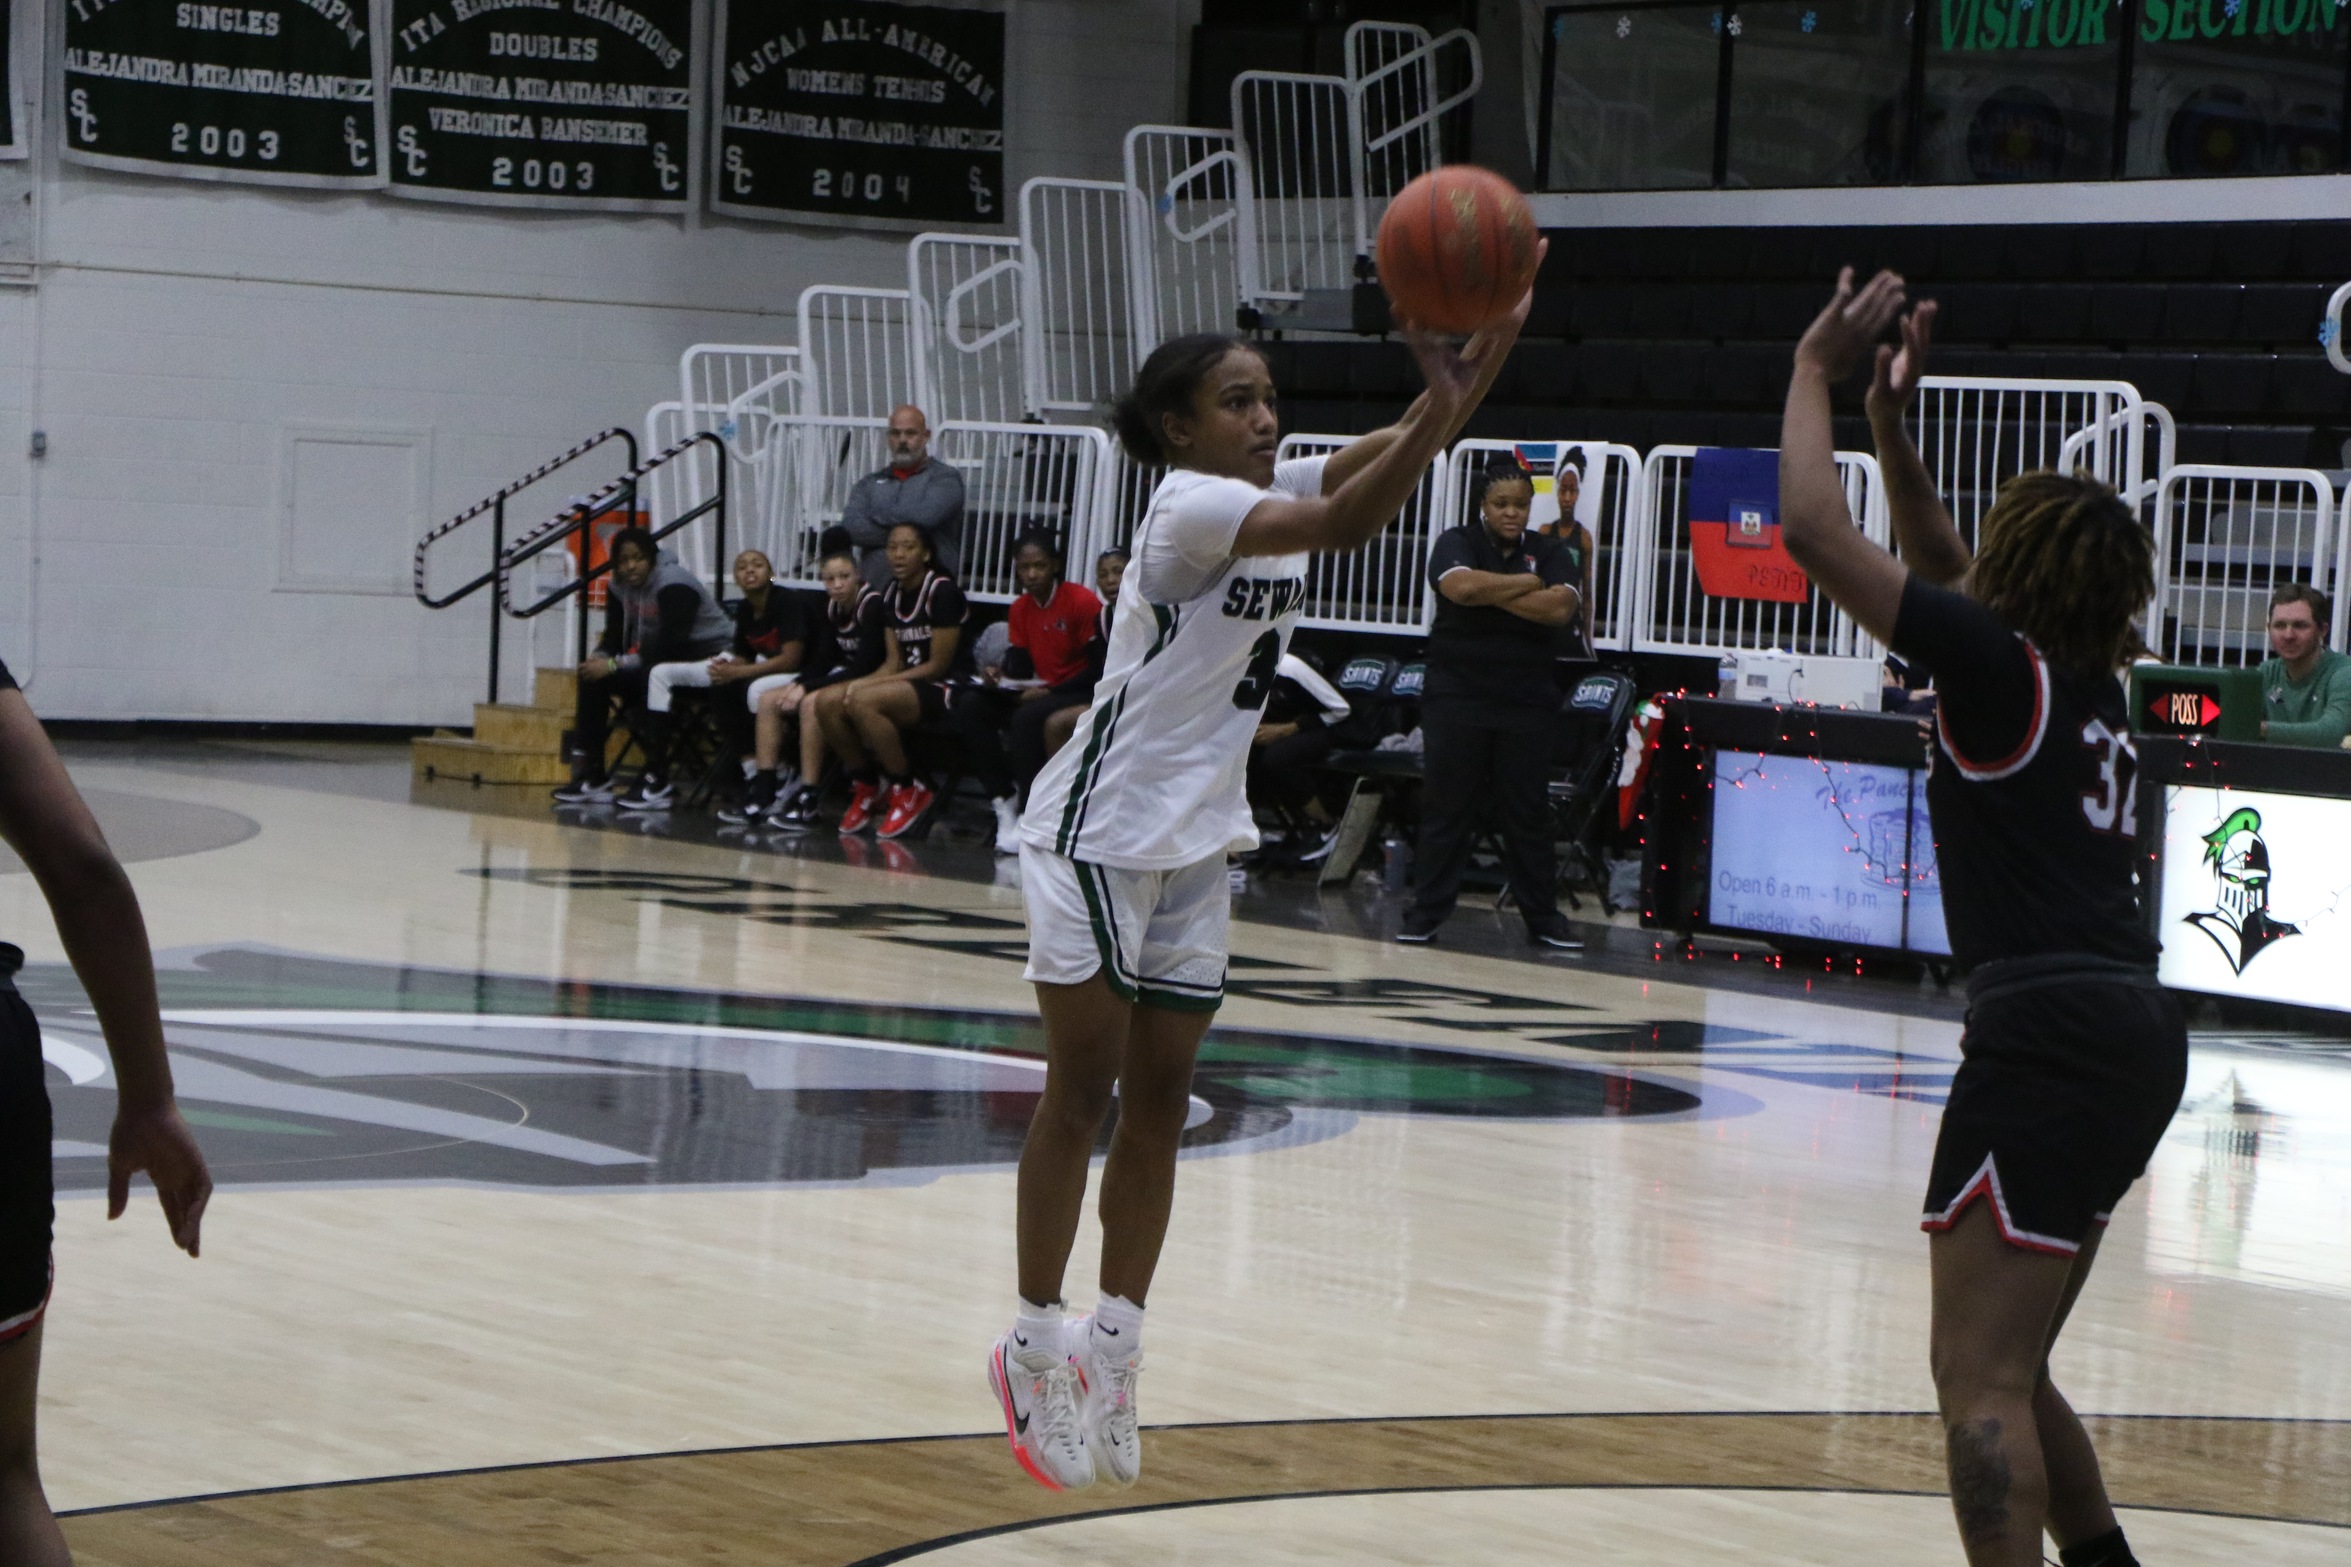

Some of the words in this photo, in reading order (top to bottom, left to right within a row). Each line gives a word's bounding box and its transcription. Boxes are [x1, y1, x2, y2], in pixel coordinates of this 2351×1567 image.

[176, 3, 281, 36] SINGLES
[399, 11, 447, 53] ITA
[489, 31, 599, 62] DOUBLES
[65, 47, 189, 87] ALEJANDRA
[391, 65, 510, 101] ALEJANDRA
[428, 107, 535, 139] VERONICA
[171, 122, 281, 160] 2003
[492, 157, 595, 191] 2003
[2171, 693, 2198, 725] POSS
[1815, 778, 1853, 811] The
[1718, 870, 1761, 896] Open
[1766, 877, 1776, 895] 6
[1833, 888, 1841, 904] 1
[1727, 905, 1794, 935] Tuesday
[1809, 916, 1872, 944] Sunday
